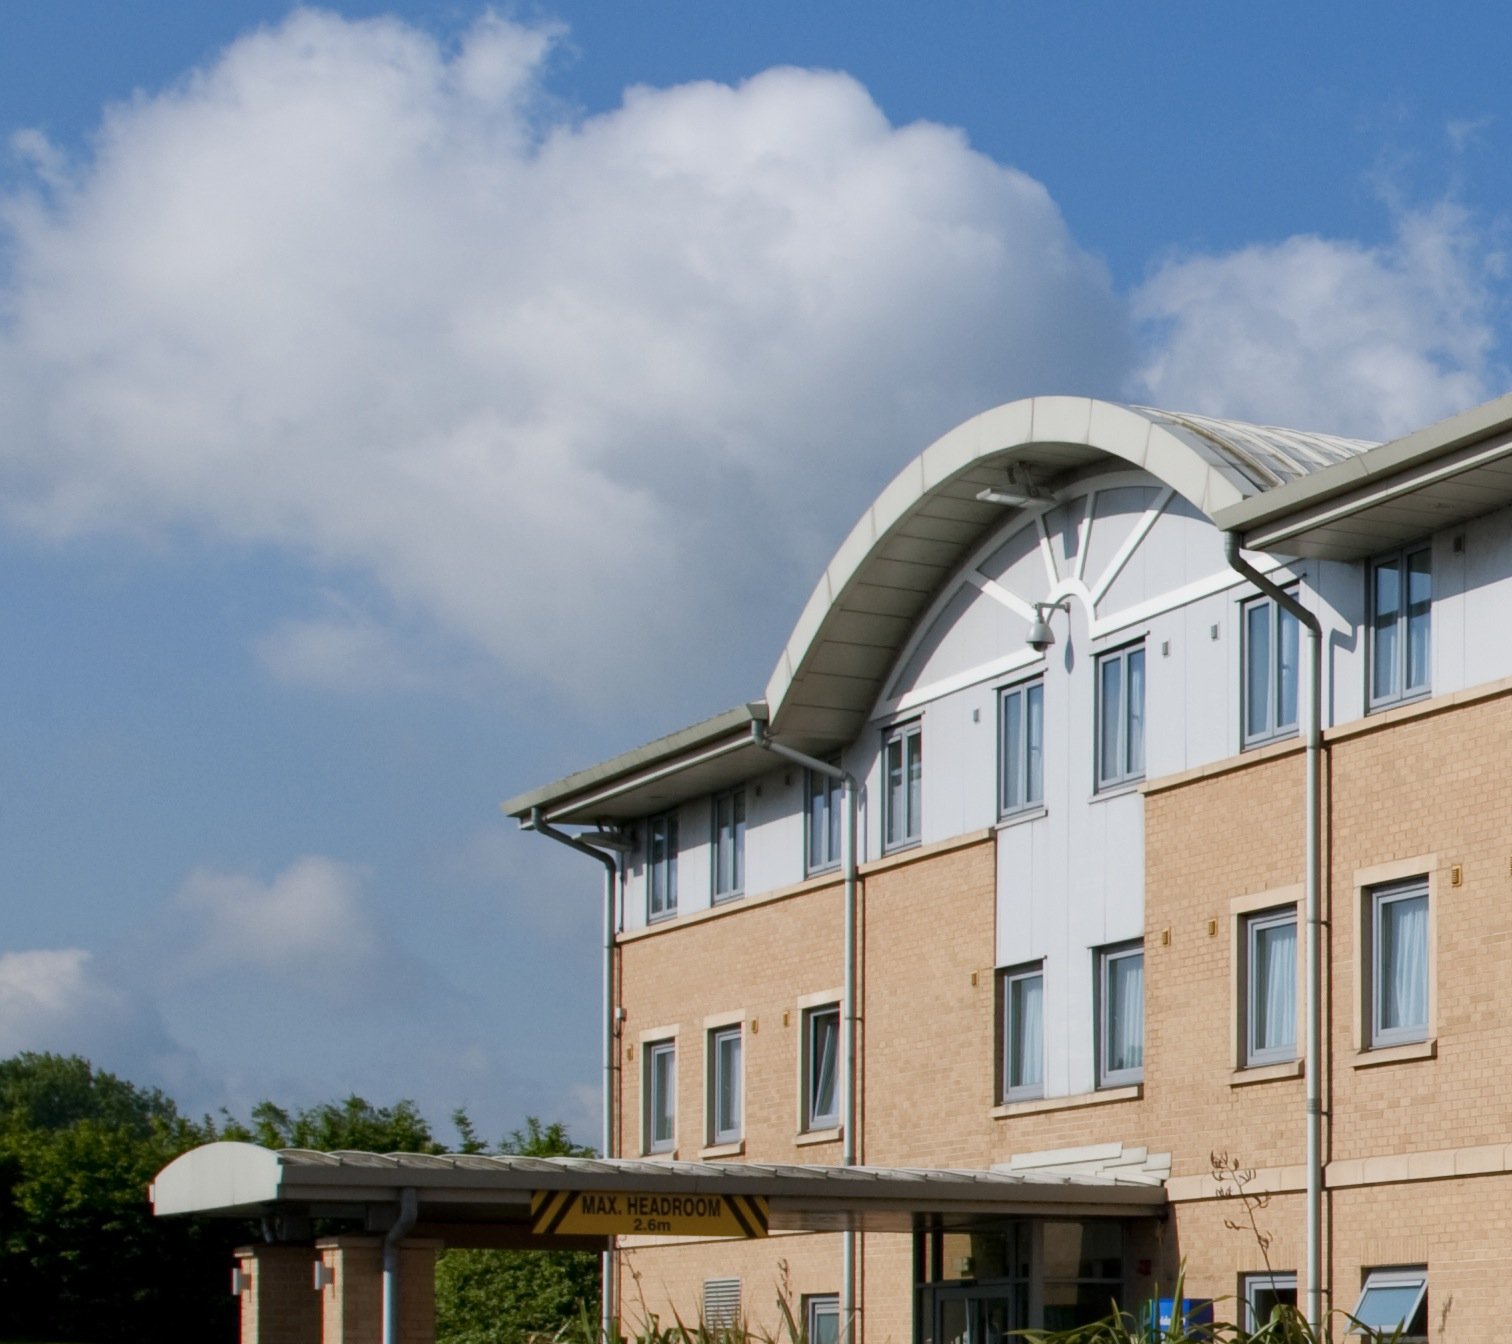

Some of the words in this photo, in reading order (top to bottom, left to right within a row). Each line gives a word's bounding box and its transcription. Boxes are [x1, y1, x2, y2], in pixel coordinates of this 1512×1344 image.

[582, 1196, 622, 1215] MAX.
[627, 1197, 721, 1217] HEADROOM
[634, 1219, 671, 1231] 2.6m
